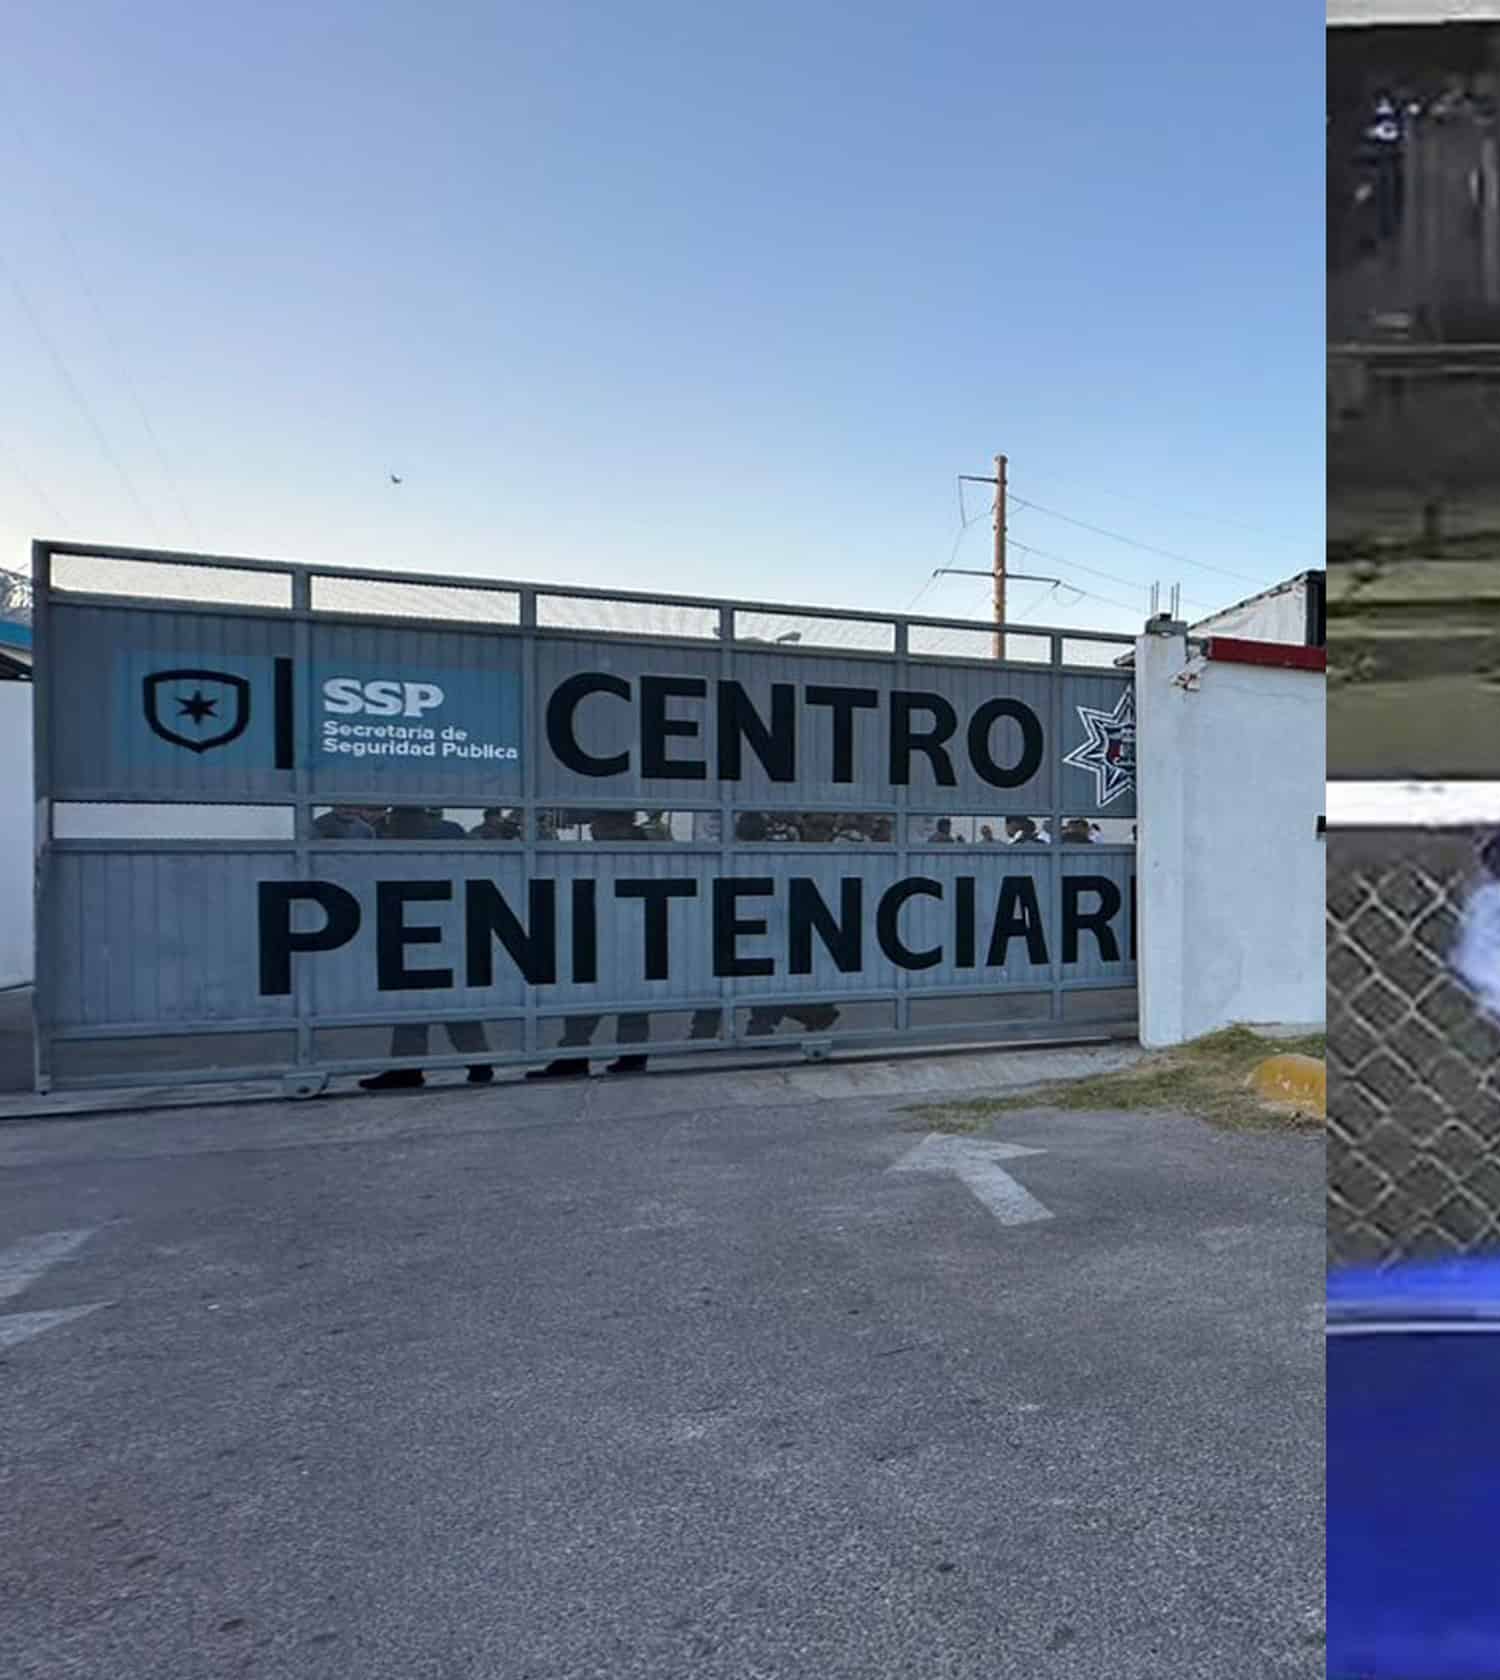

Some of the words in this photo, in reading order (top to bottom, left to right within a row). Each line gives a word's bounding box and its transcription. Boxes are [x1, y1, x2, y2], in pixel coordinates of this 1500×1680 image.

[323, 678, 444, 717] SSP
[441, 725, 467, 741] de
[546, 672, 1044, 788] CENTRO
[323, 738, 435, 757] Seguridad
